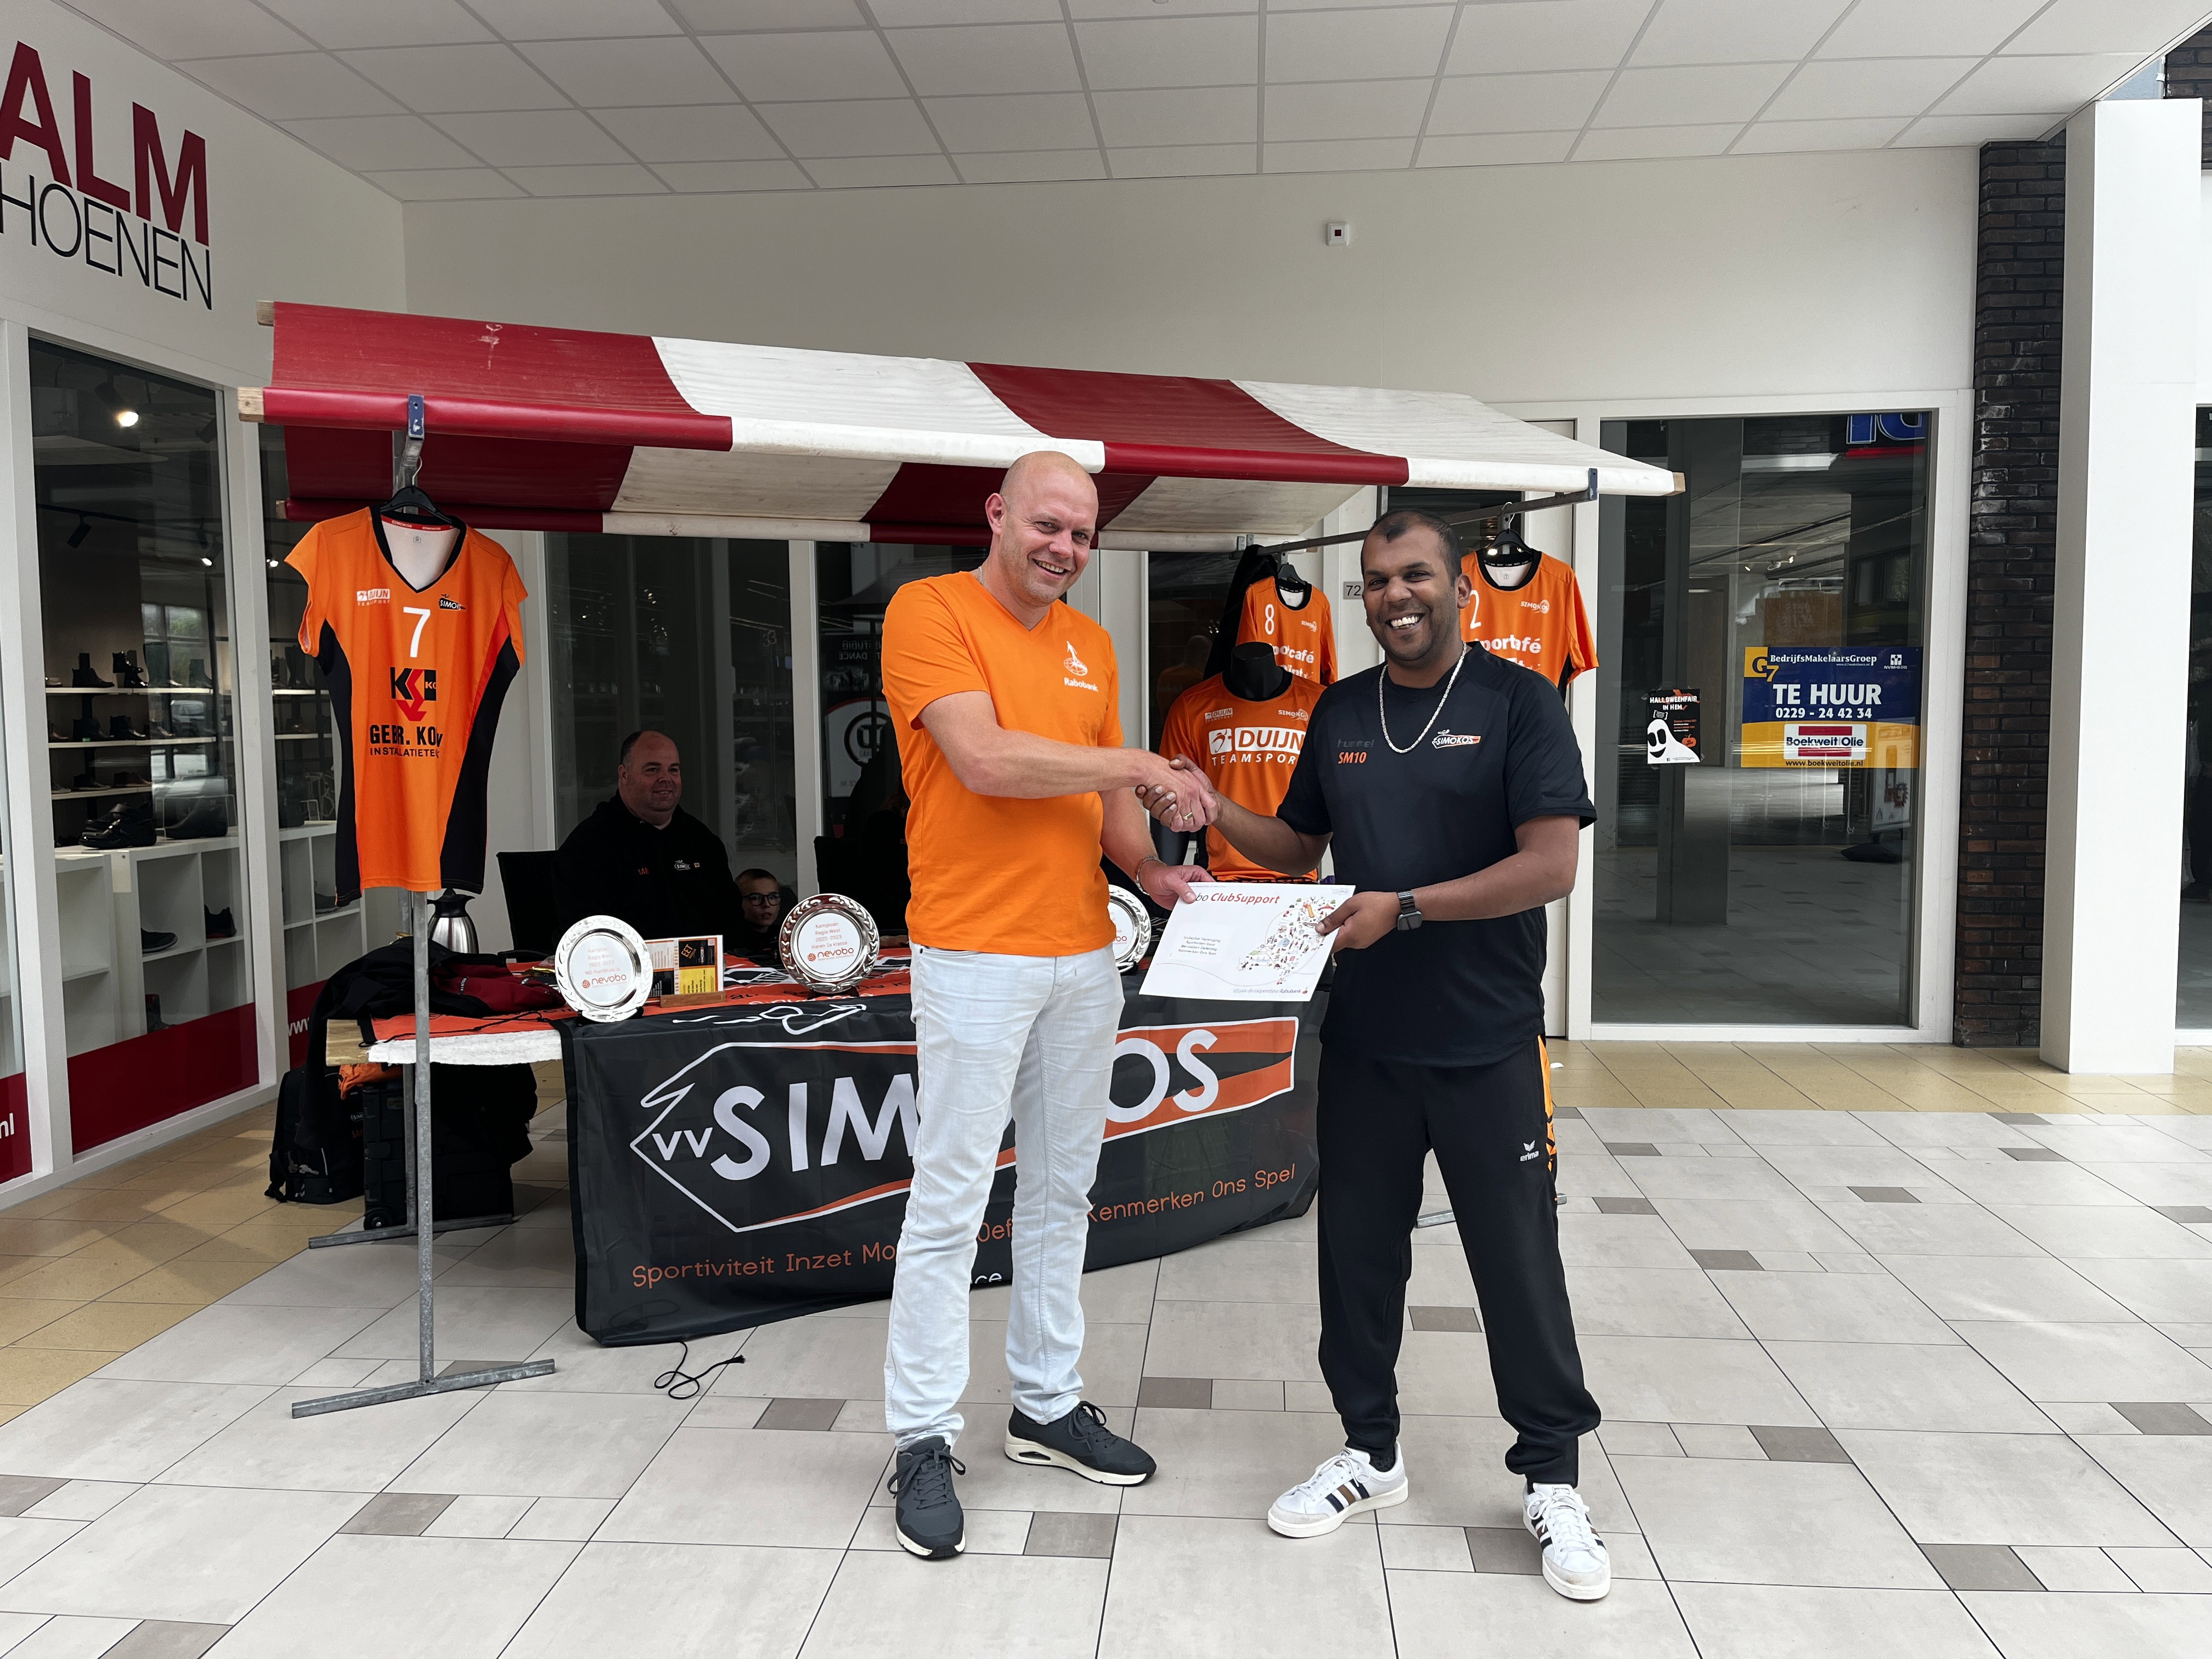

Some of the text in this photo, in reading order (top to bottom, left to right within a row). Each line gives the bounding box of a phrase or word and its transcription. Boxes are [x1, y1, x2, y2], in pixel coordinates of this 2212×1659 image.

[1265, 603, 1274, 635] 8
[403, 606, 431, 658] 7
[1770, 654, 1877, 666] BedrijfsMakelaarsGroep
[1064, 677, 1099, 692] Rabobank
[1773, 684, 1882, 705] TE HUUR
[1775, 707, 1805, 719] 0229
[1818, 708, 1833, 719] 24
[1837, 708, 1853, 719] 42
[1857, 708, 1872, 719] 34
[1238, 729, 1305, 751] DUIJN
[1436, 735, 1474, 745] SIMOKOS
[1786, 737, 1864, 747] Boekweit Olie
[1338, 752, 1367, 764] SM10
[1210, 893, 1280, 906] ClubSupport
[817, 947, 854, 958] nevobo
[591, 974, 627, 985] nevobo
[1520, 1150, 1539, 1162] erima
[632, 1257, 774, 1289] Sportiviteit
[785, 1249, 851, 1273] Inzet
[1211, 1178, 1246, 1199] Ons
[1254, 1163, 1296, 1192] Spel
